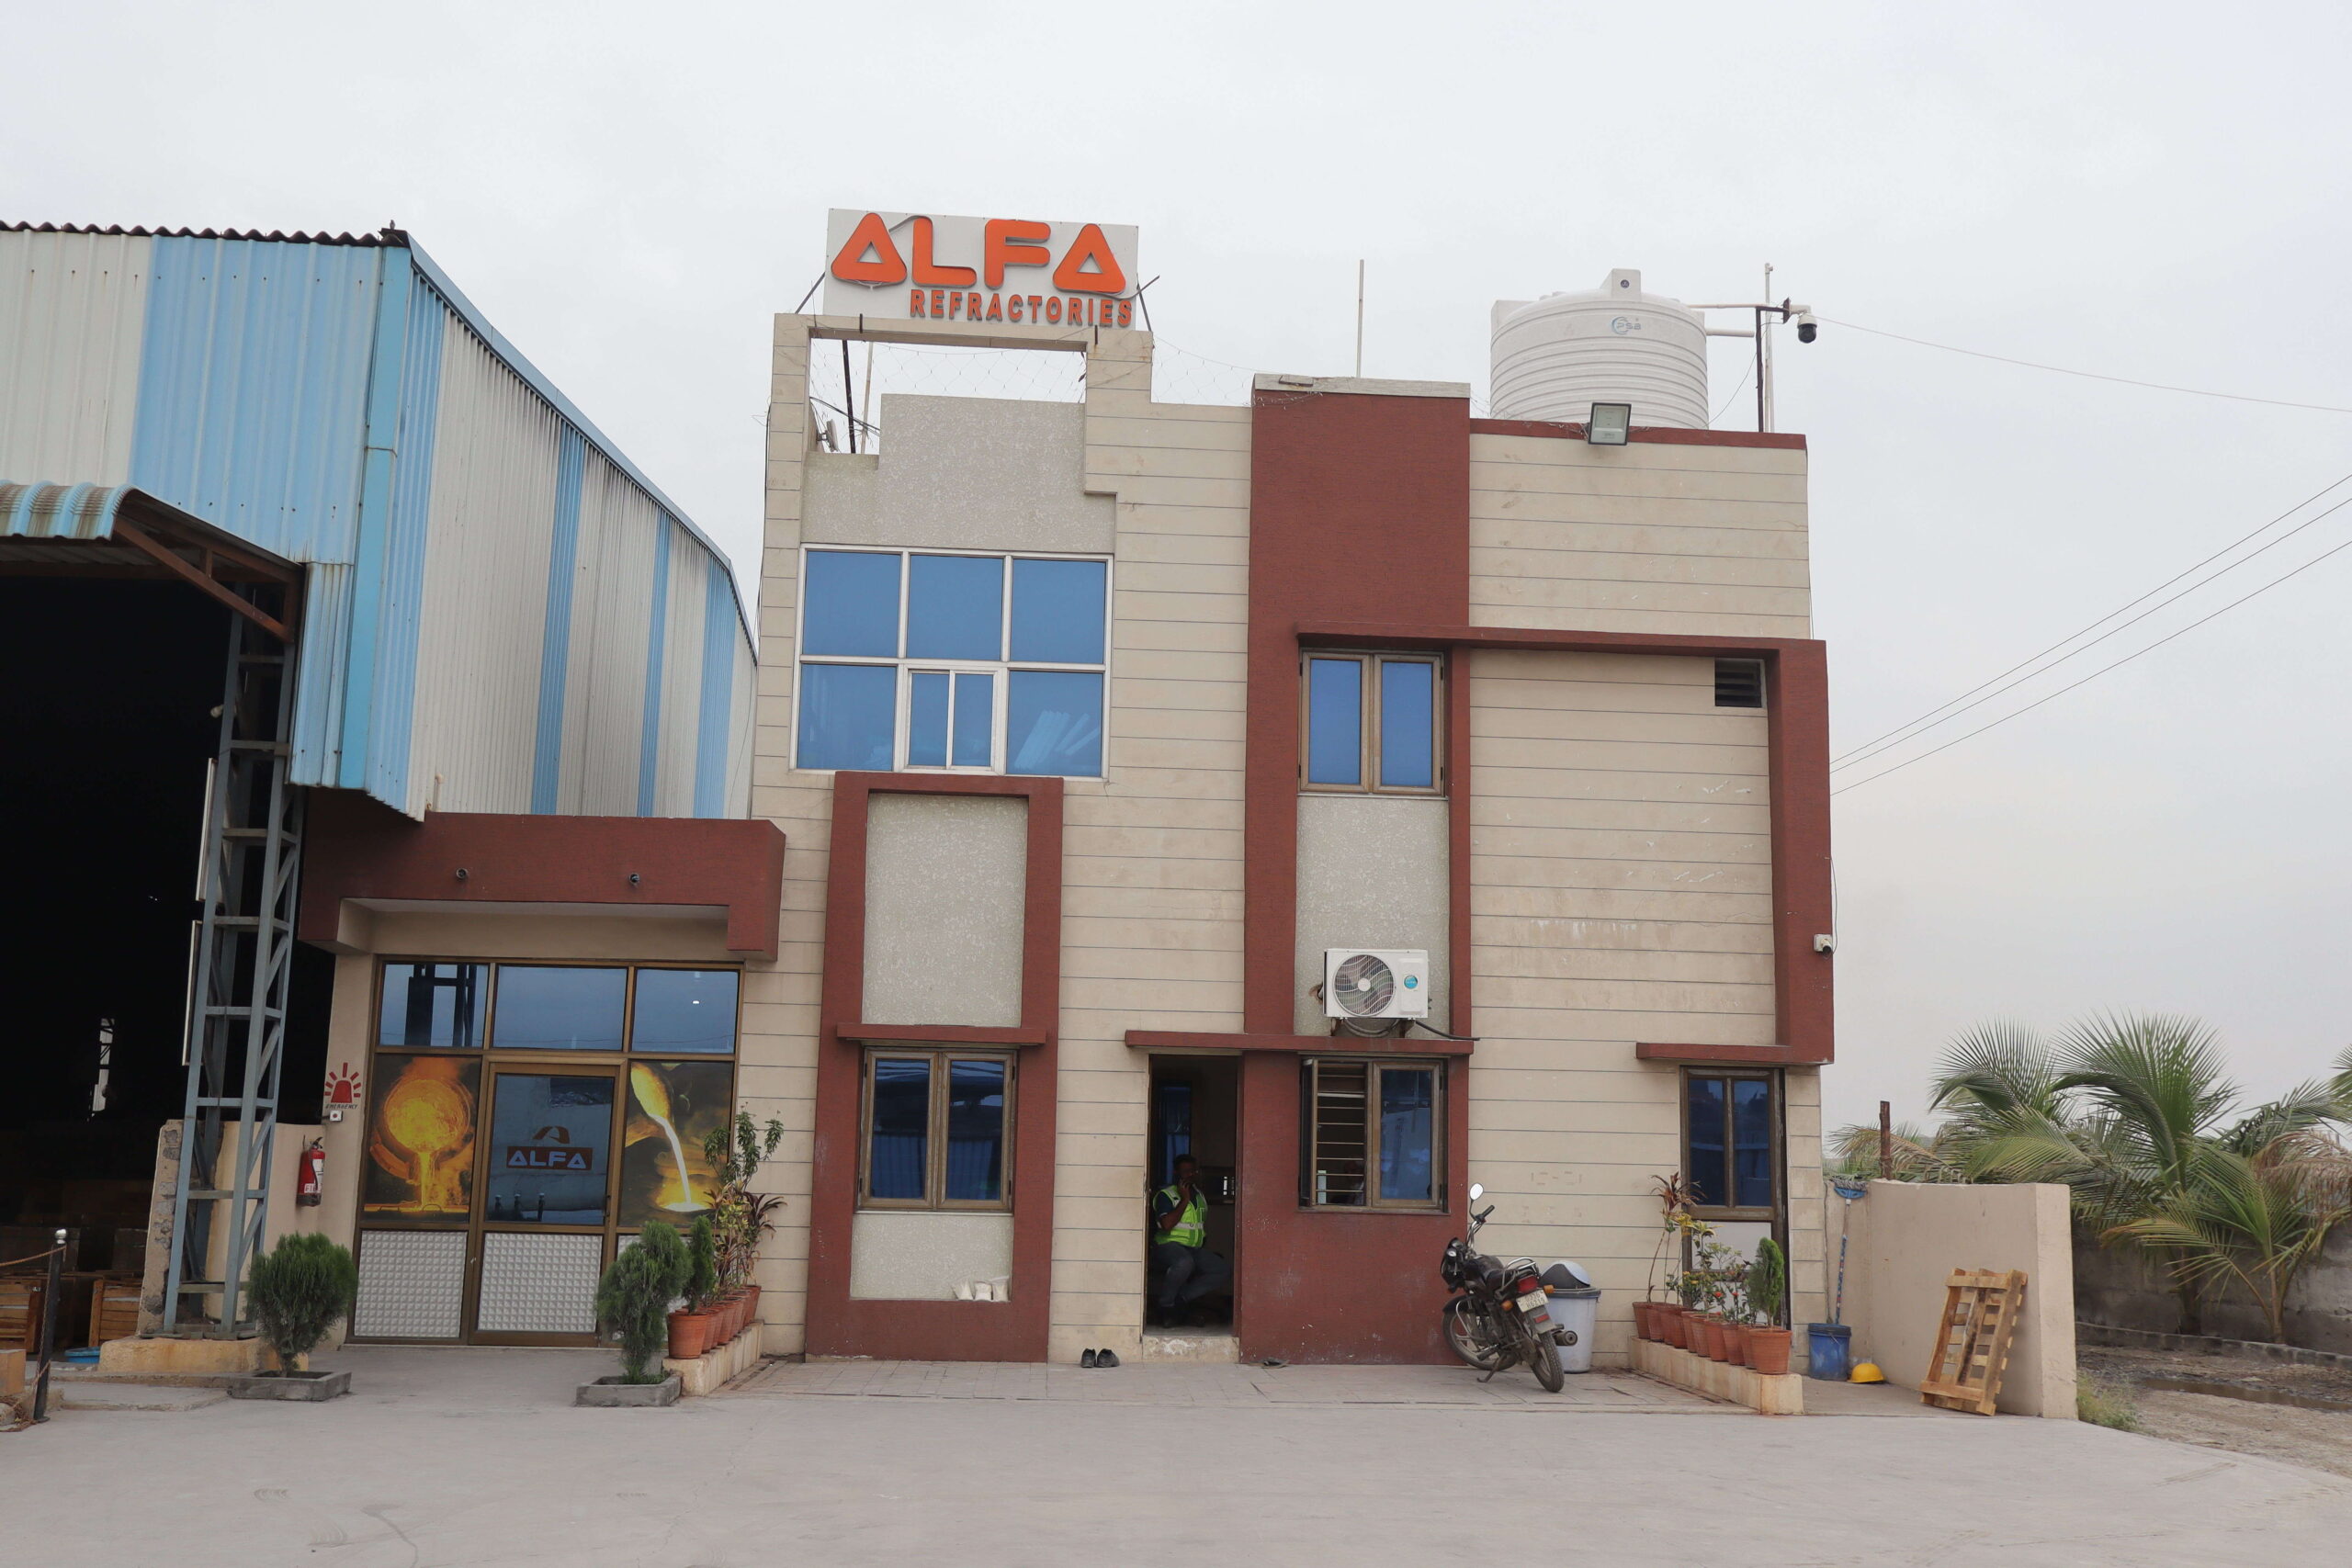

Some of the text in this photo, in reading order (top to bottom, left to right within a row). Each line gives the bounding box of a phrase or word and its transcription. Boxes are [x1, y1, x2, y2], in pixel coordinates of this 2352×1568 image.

[831, 212, 1126, 294] ALFA
[910, 289, 1133, 327] REFRACTORIES
[508, 1150, 586, 1168] ALFA
